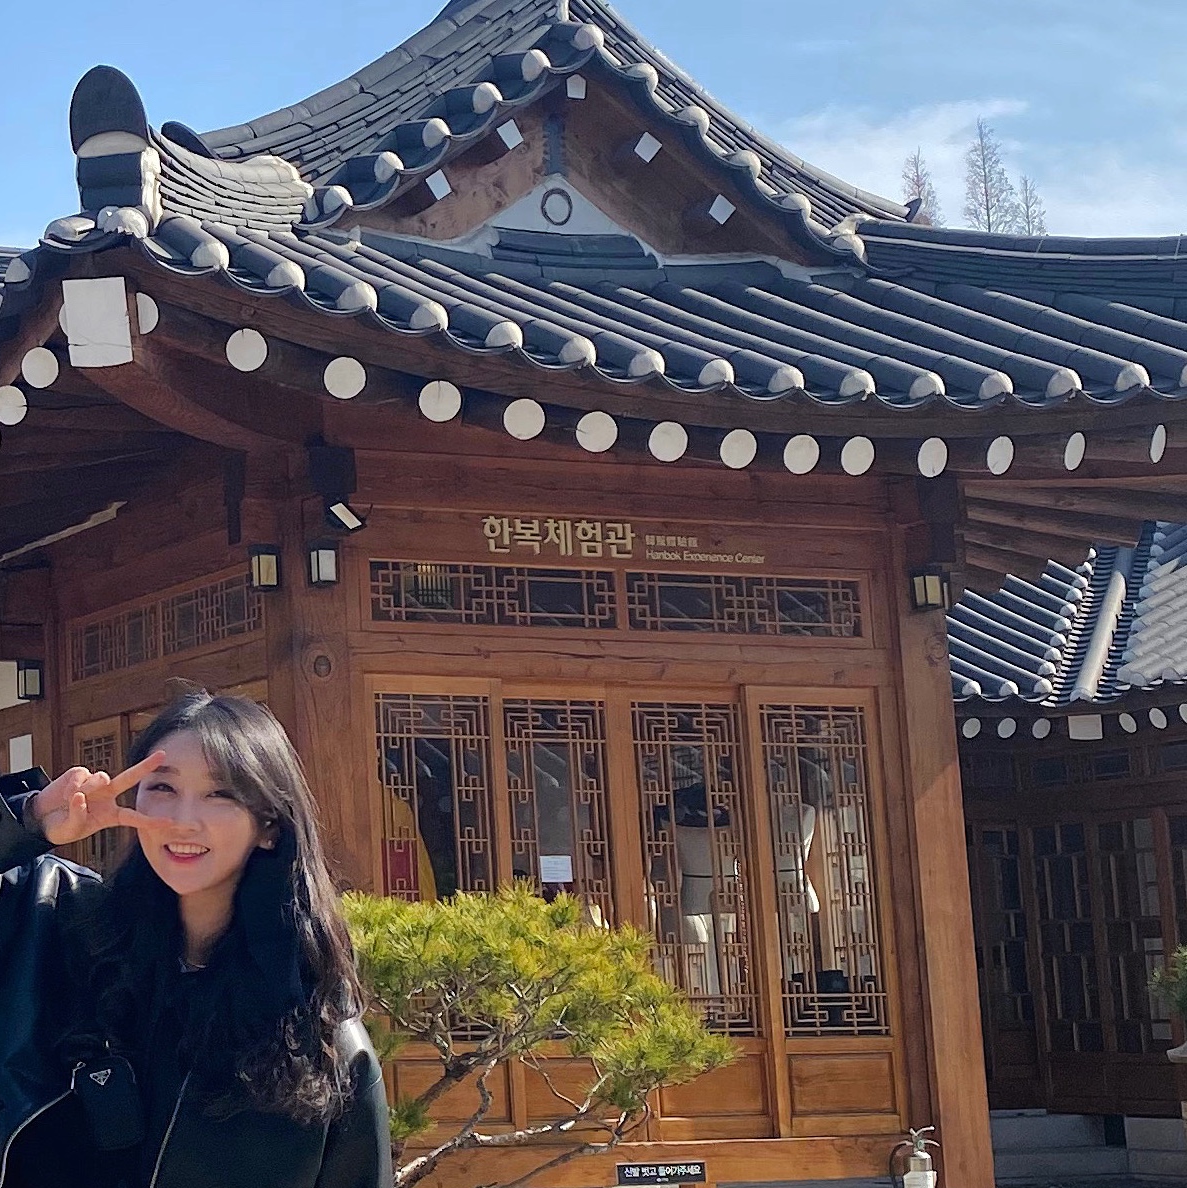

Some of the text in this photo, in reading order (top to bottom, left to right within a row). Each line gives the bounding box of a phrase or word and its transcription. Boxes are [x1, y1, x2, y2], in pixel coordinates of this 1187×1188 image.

[481, 515, 636, 559] 한복체험관
[645, 549, 766, 564] Hanbok Experience Center
[641, 1166, 658, 1178] 벗고
